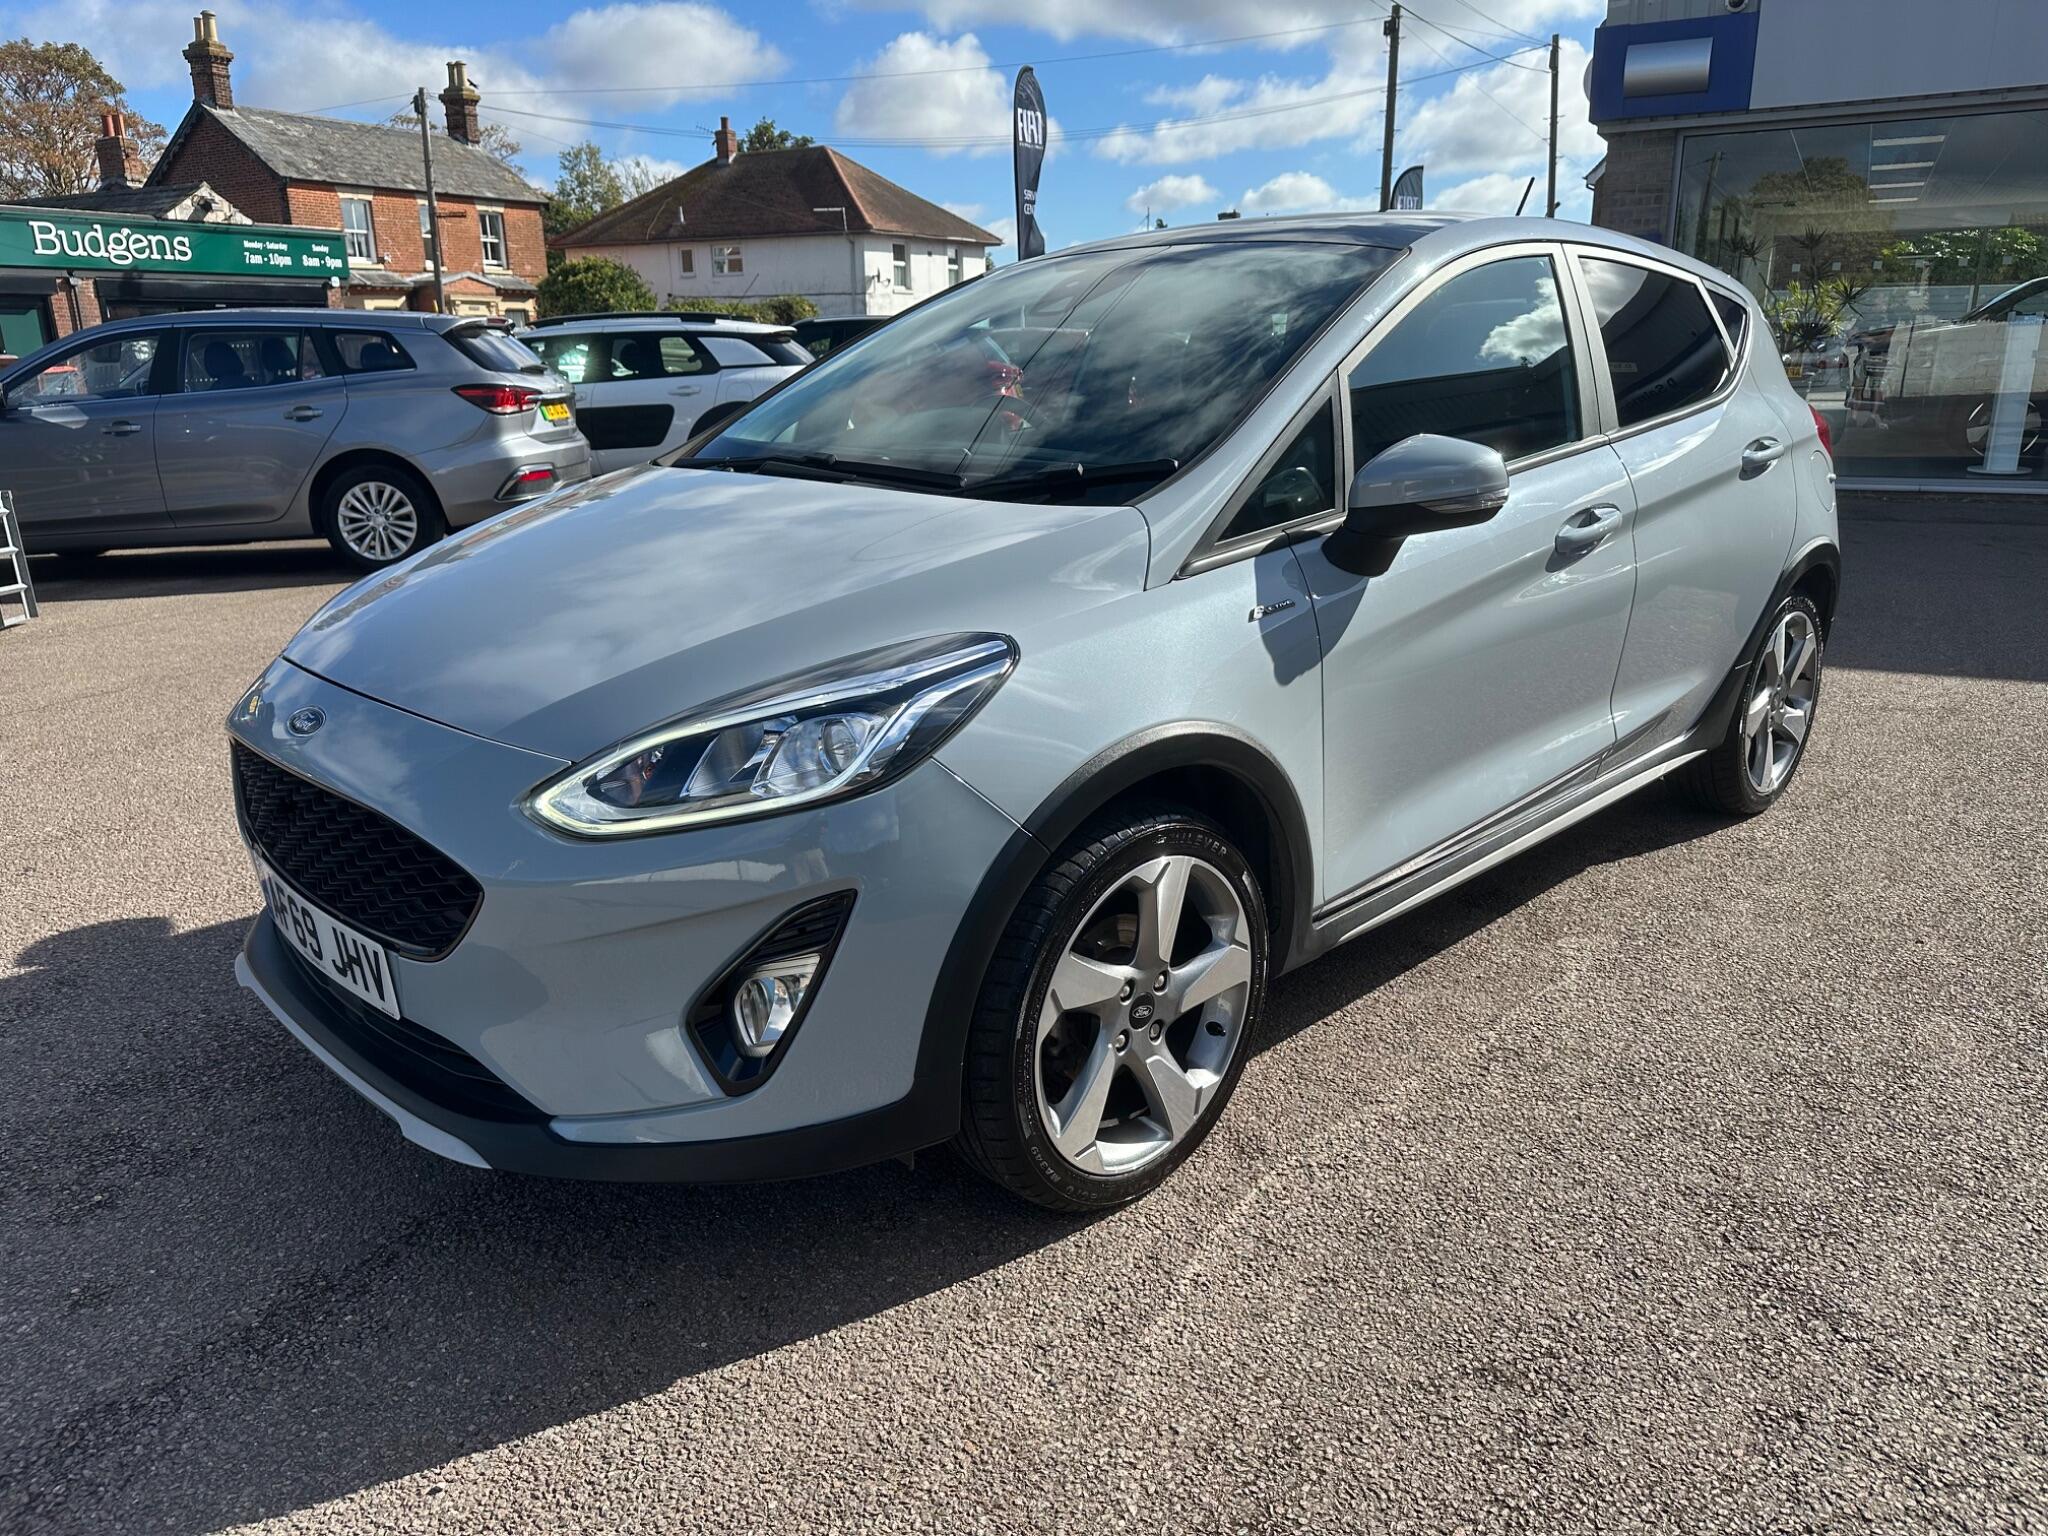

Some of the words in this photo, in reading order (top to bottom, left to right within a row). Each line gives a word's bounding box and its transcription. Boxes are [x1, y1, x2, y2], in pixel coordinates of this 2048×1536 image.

[1017, 107, 1043, 145] FIAT
[28, 220, 193, 265] Budgens
[243, 240, 263, 250] Monday
[266, 241, 288, 251] Saturday
[311, 243, 329, 254] Sunday
[243, 252, 263, 264] 7am
[269, 253, 292, 267] 10pm
[302, 254, 320, 267] 8am
[325, 255, 343, 270] 9pm
[268, 875, 324, 961] AF69
[332, 925, 386, 1003] JHV
